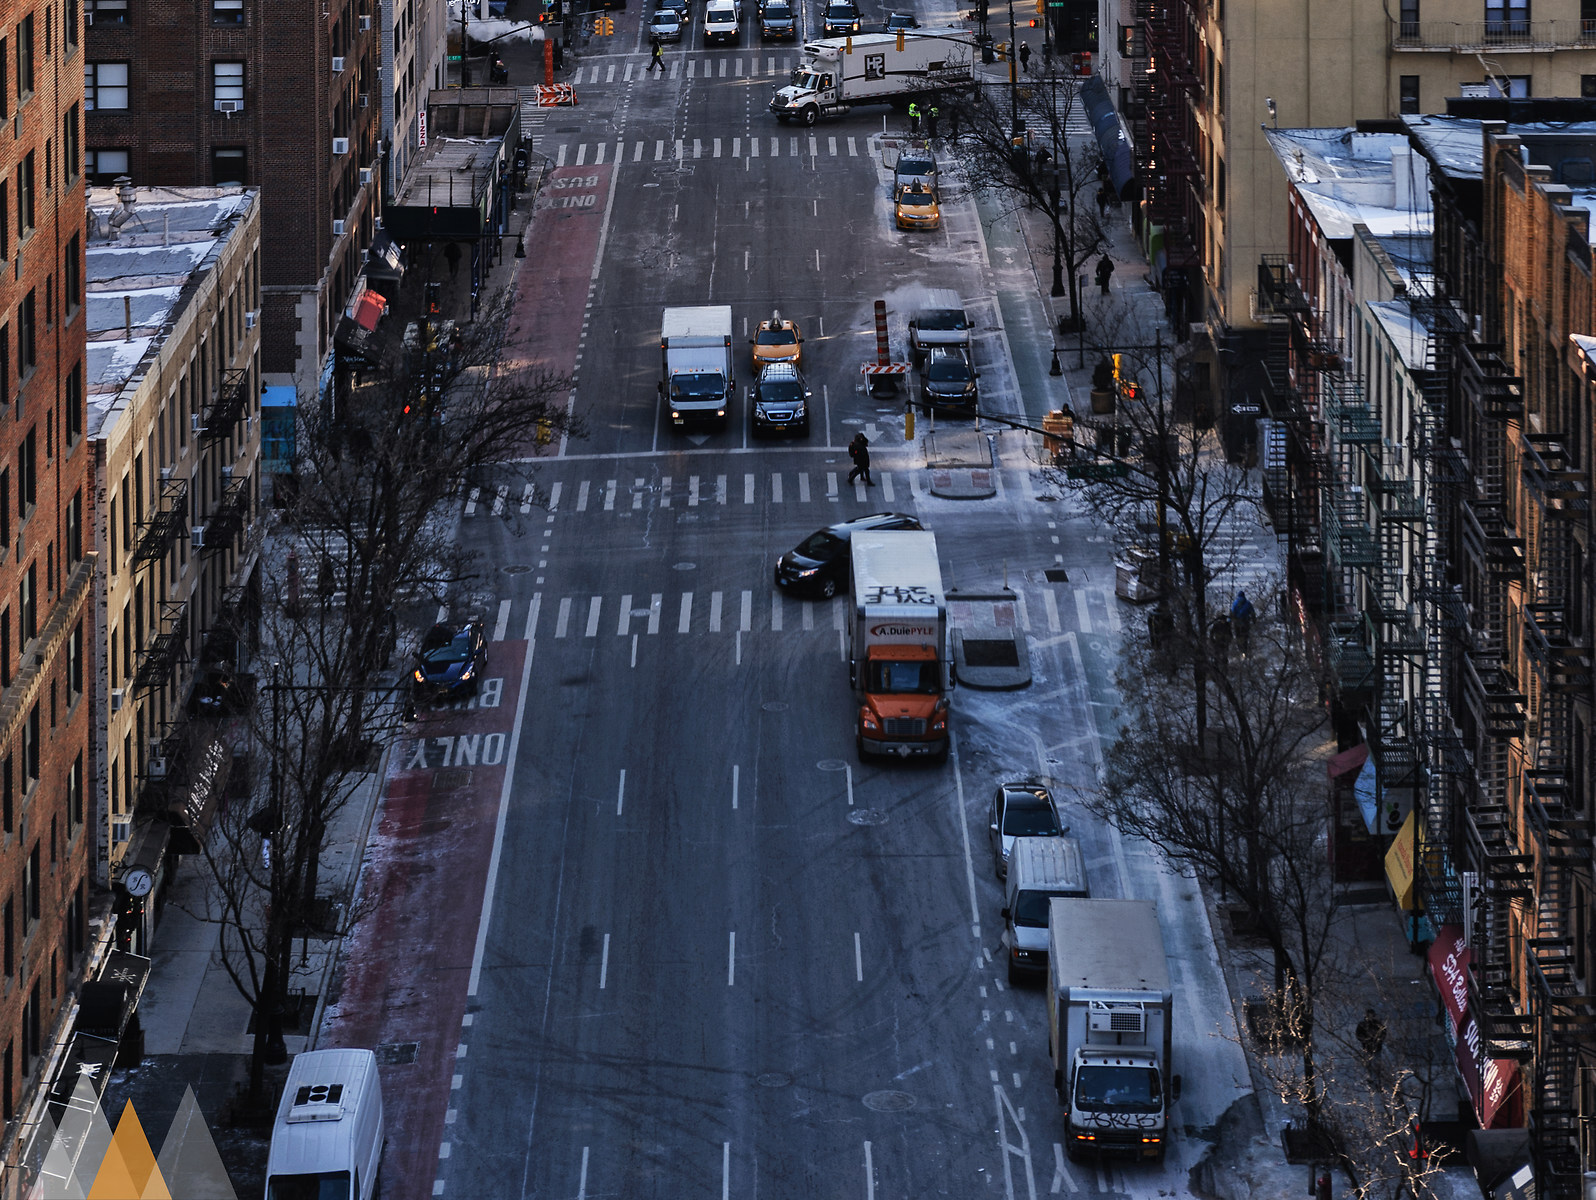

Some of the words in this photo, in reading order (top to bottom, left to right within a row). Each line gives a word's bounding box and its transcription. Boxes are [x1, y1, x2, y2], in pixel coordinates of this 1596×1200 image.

[555, 175, 599, 189] BUS
[542, 194, 597, 210] ONLY
[405, 732, 506, 769] ONLY
[1442, 953, 1460, 985] SPA
